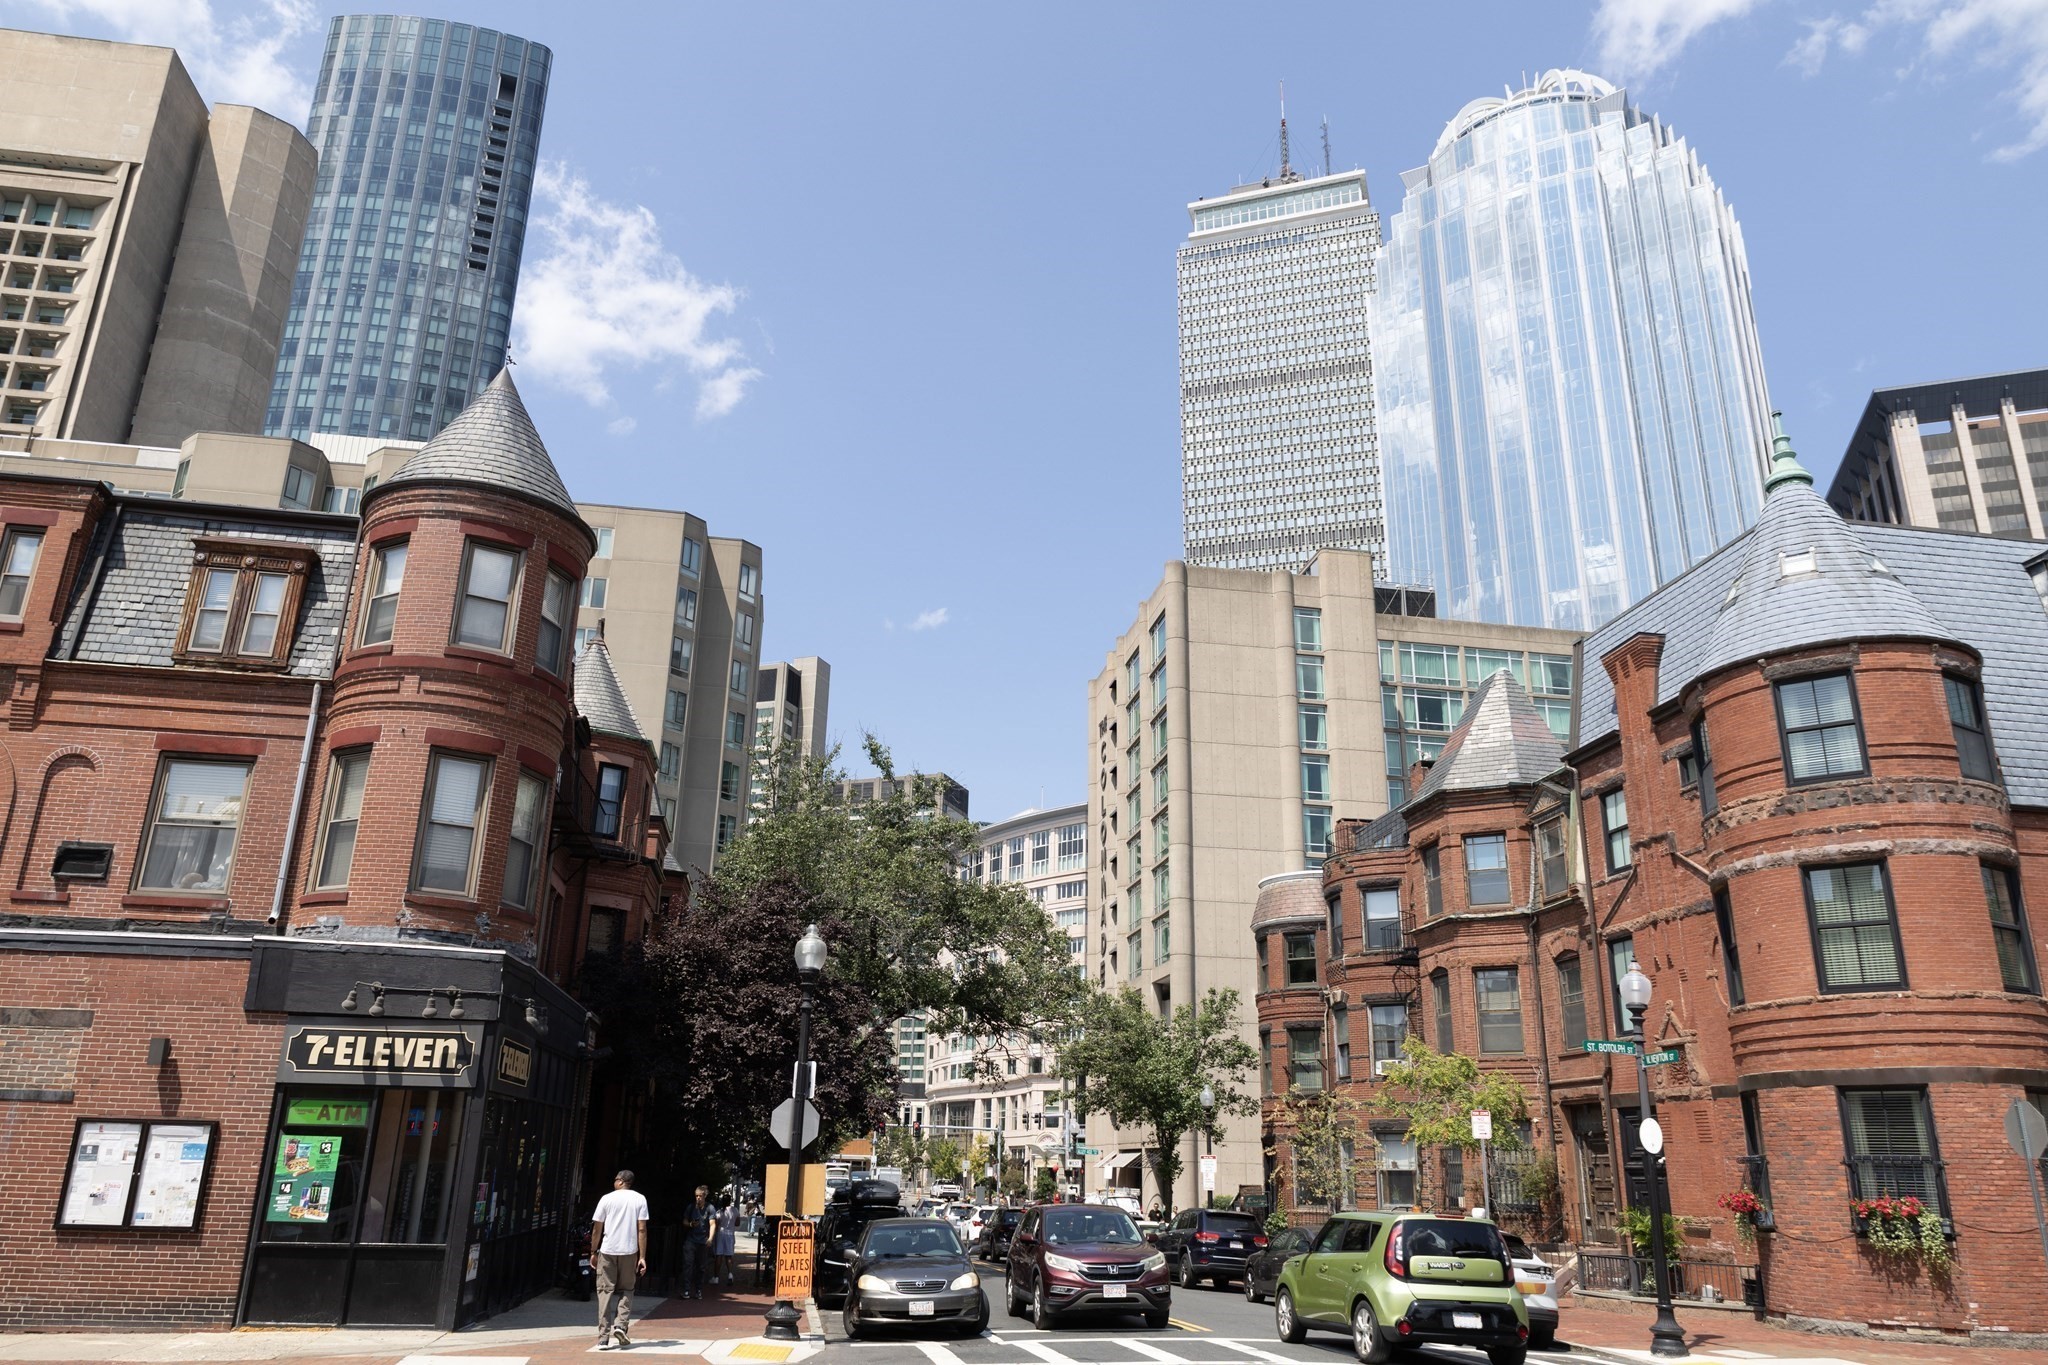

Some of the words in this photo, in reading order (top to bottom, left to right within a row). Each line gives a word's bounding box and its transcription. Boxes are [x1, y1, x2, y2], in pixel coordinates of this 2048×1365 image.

[1100, 741, 1108, 989] COLONNADE
[1586, 1042, 1598, 1052] ST.
[1598, 1043, 1626, 1054] BOTOLPH
[1627, 1046, 1634, 1055] ST
[1669, 1053, 1675, 1061] ST
[316, 1104, 363, 1121] ATM
[321, 1142, 332, 1153] $3
[280, 1183, 292, 1194] $4
[782, 1225, 811, 1237] CAUTION
[782, 1242, 809, 1254] STEEL
[779, 1258, 810, 1271] PLATES
[778, 1275, 809, 1288] AHEAD
